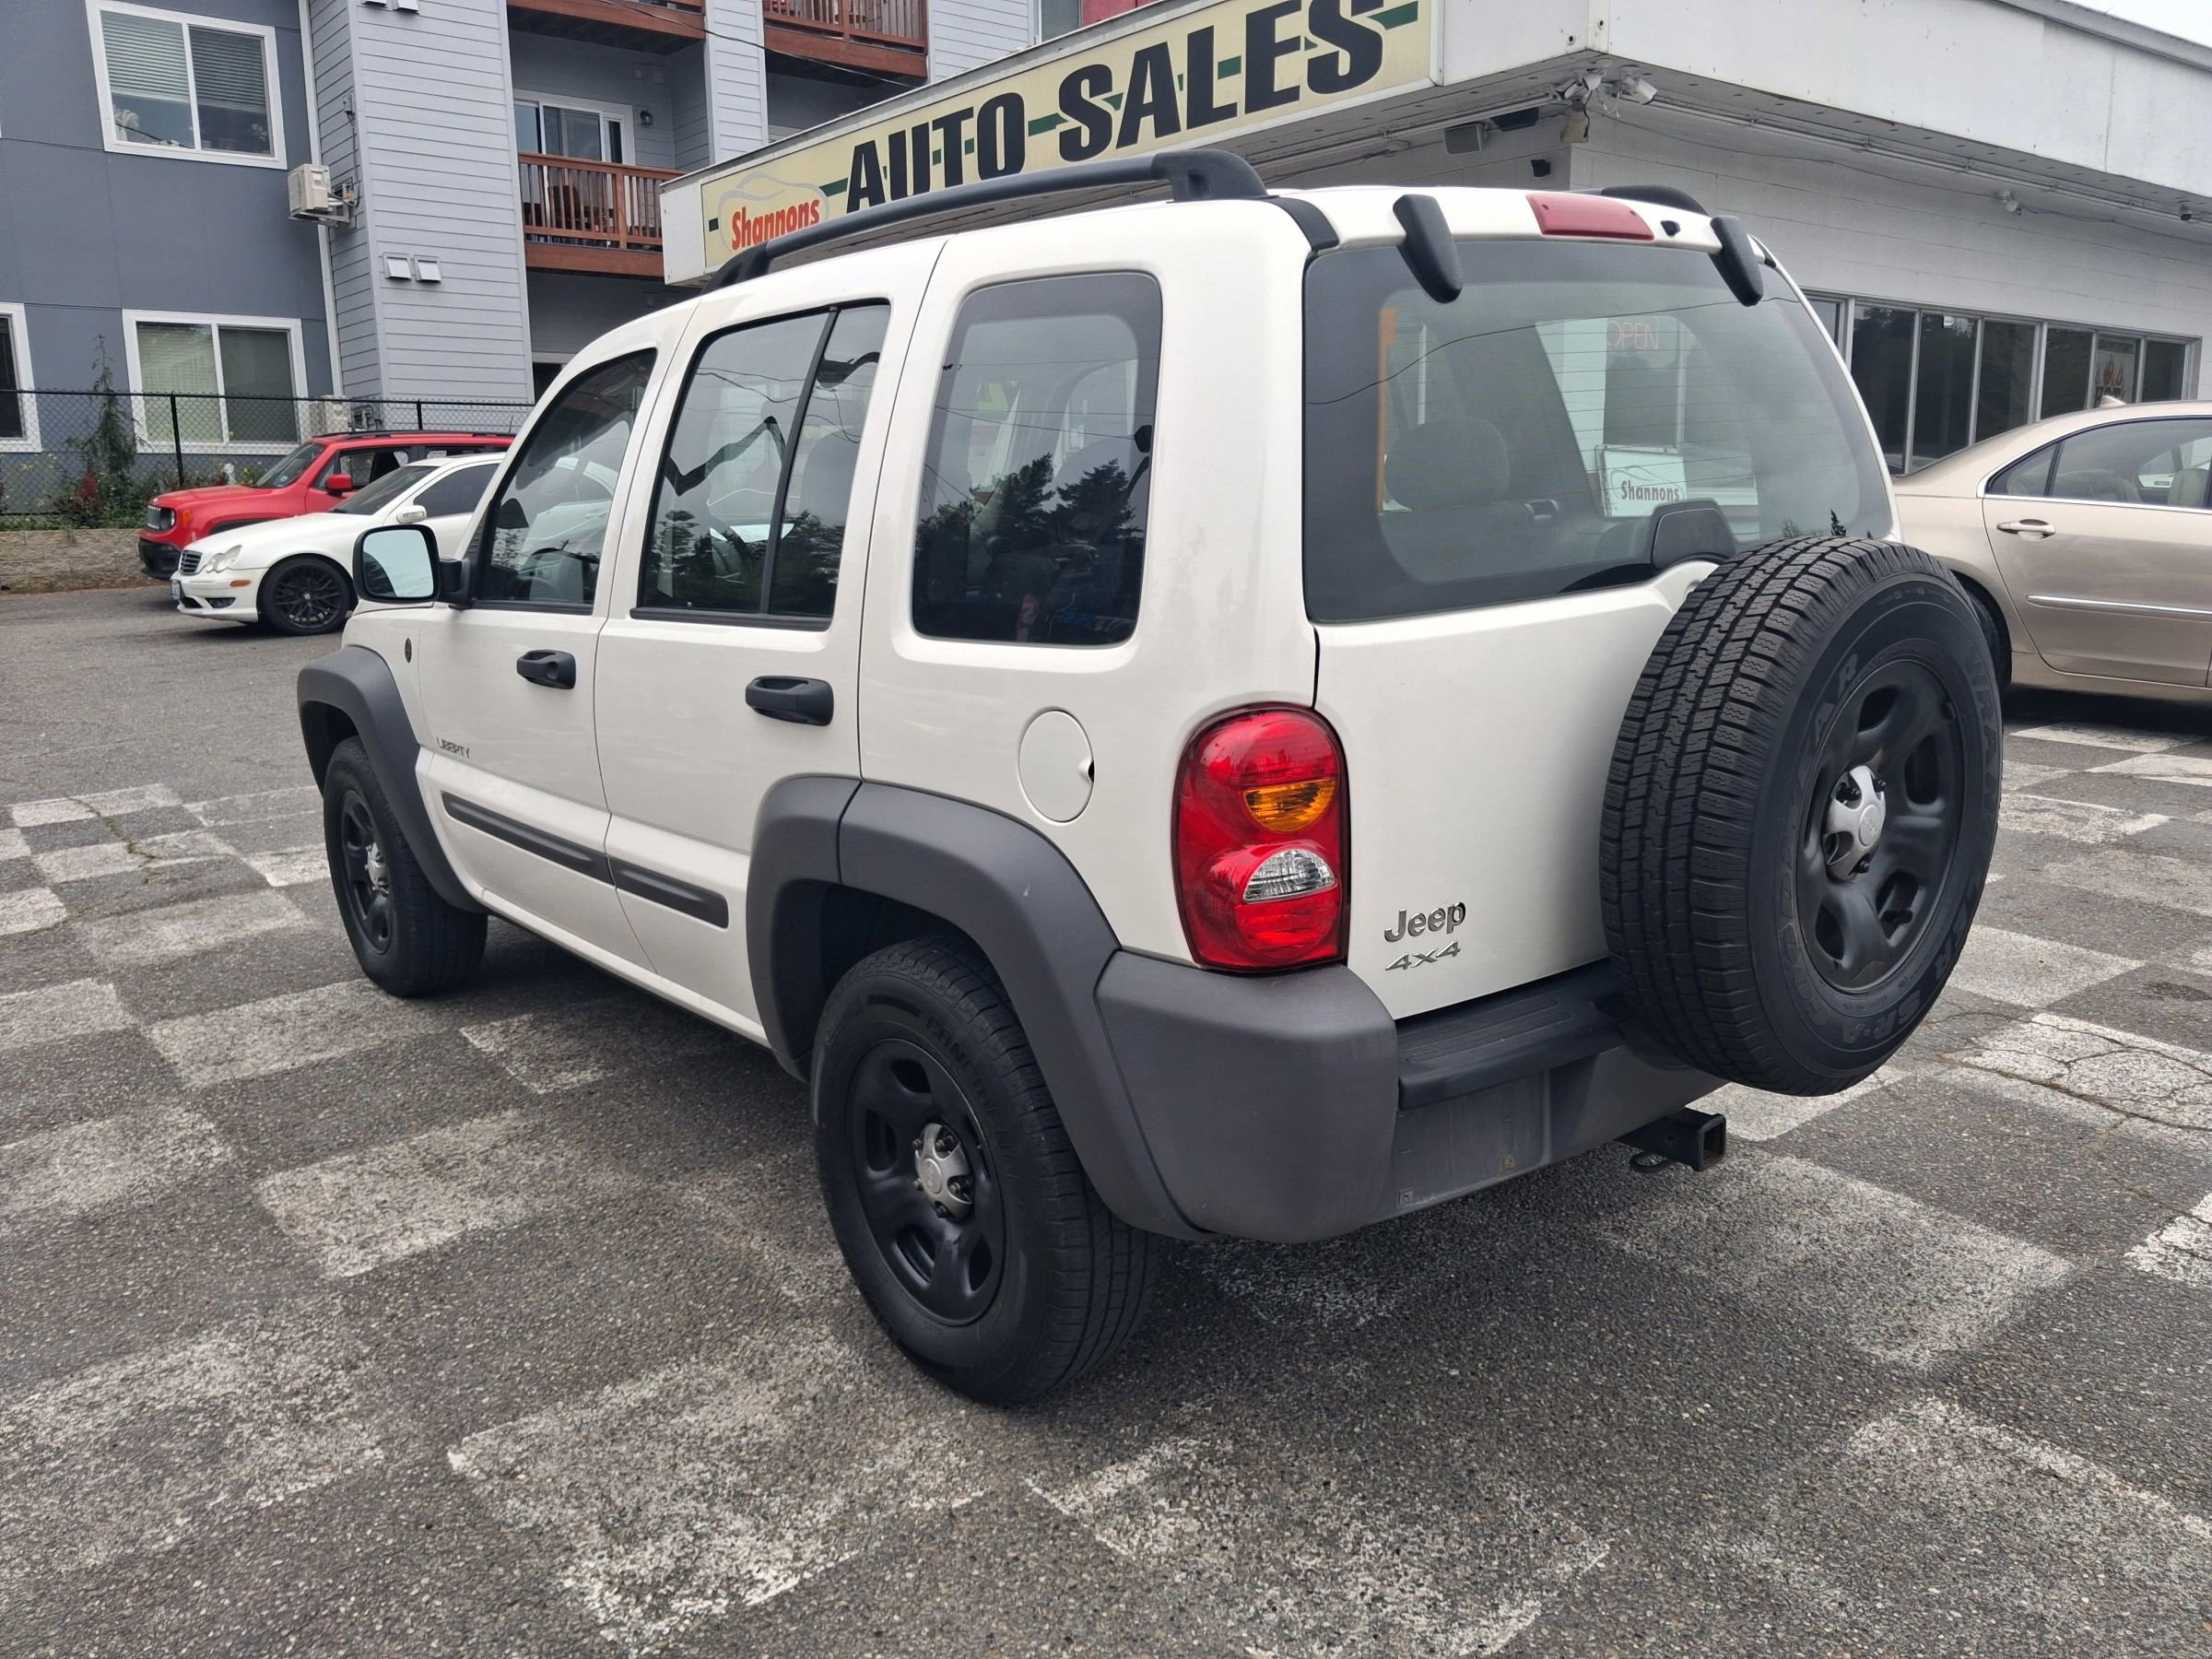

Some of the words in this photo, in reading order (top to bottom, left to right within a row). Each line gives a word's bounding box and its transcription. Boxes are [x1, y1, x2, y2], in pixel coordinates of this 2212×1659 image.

[846, 92, 1026, 214] AUTO
[1058, 0, 1384, 162] SALES
[731, 198, 820, 252] Shannons
[1606, 320, 1659, 350] OPEN
[1620, 479, 1680, 503] Shannons
[1384, 901, 1466, 942] Jeep
